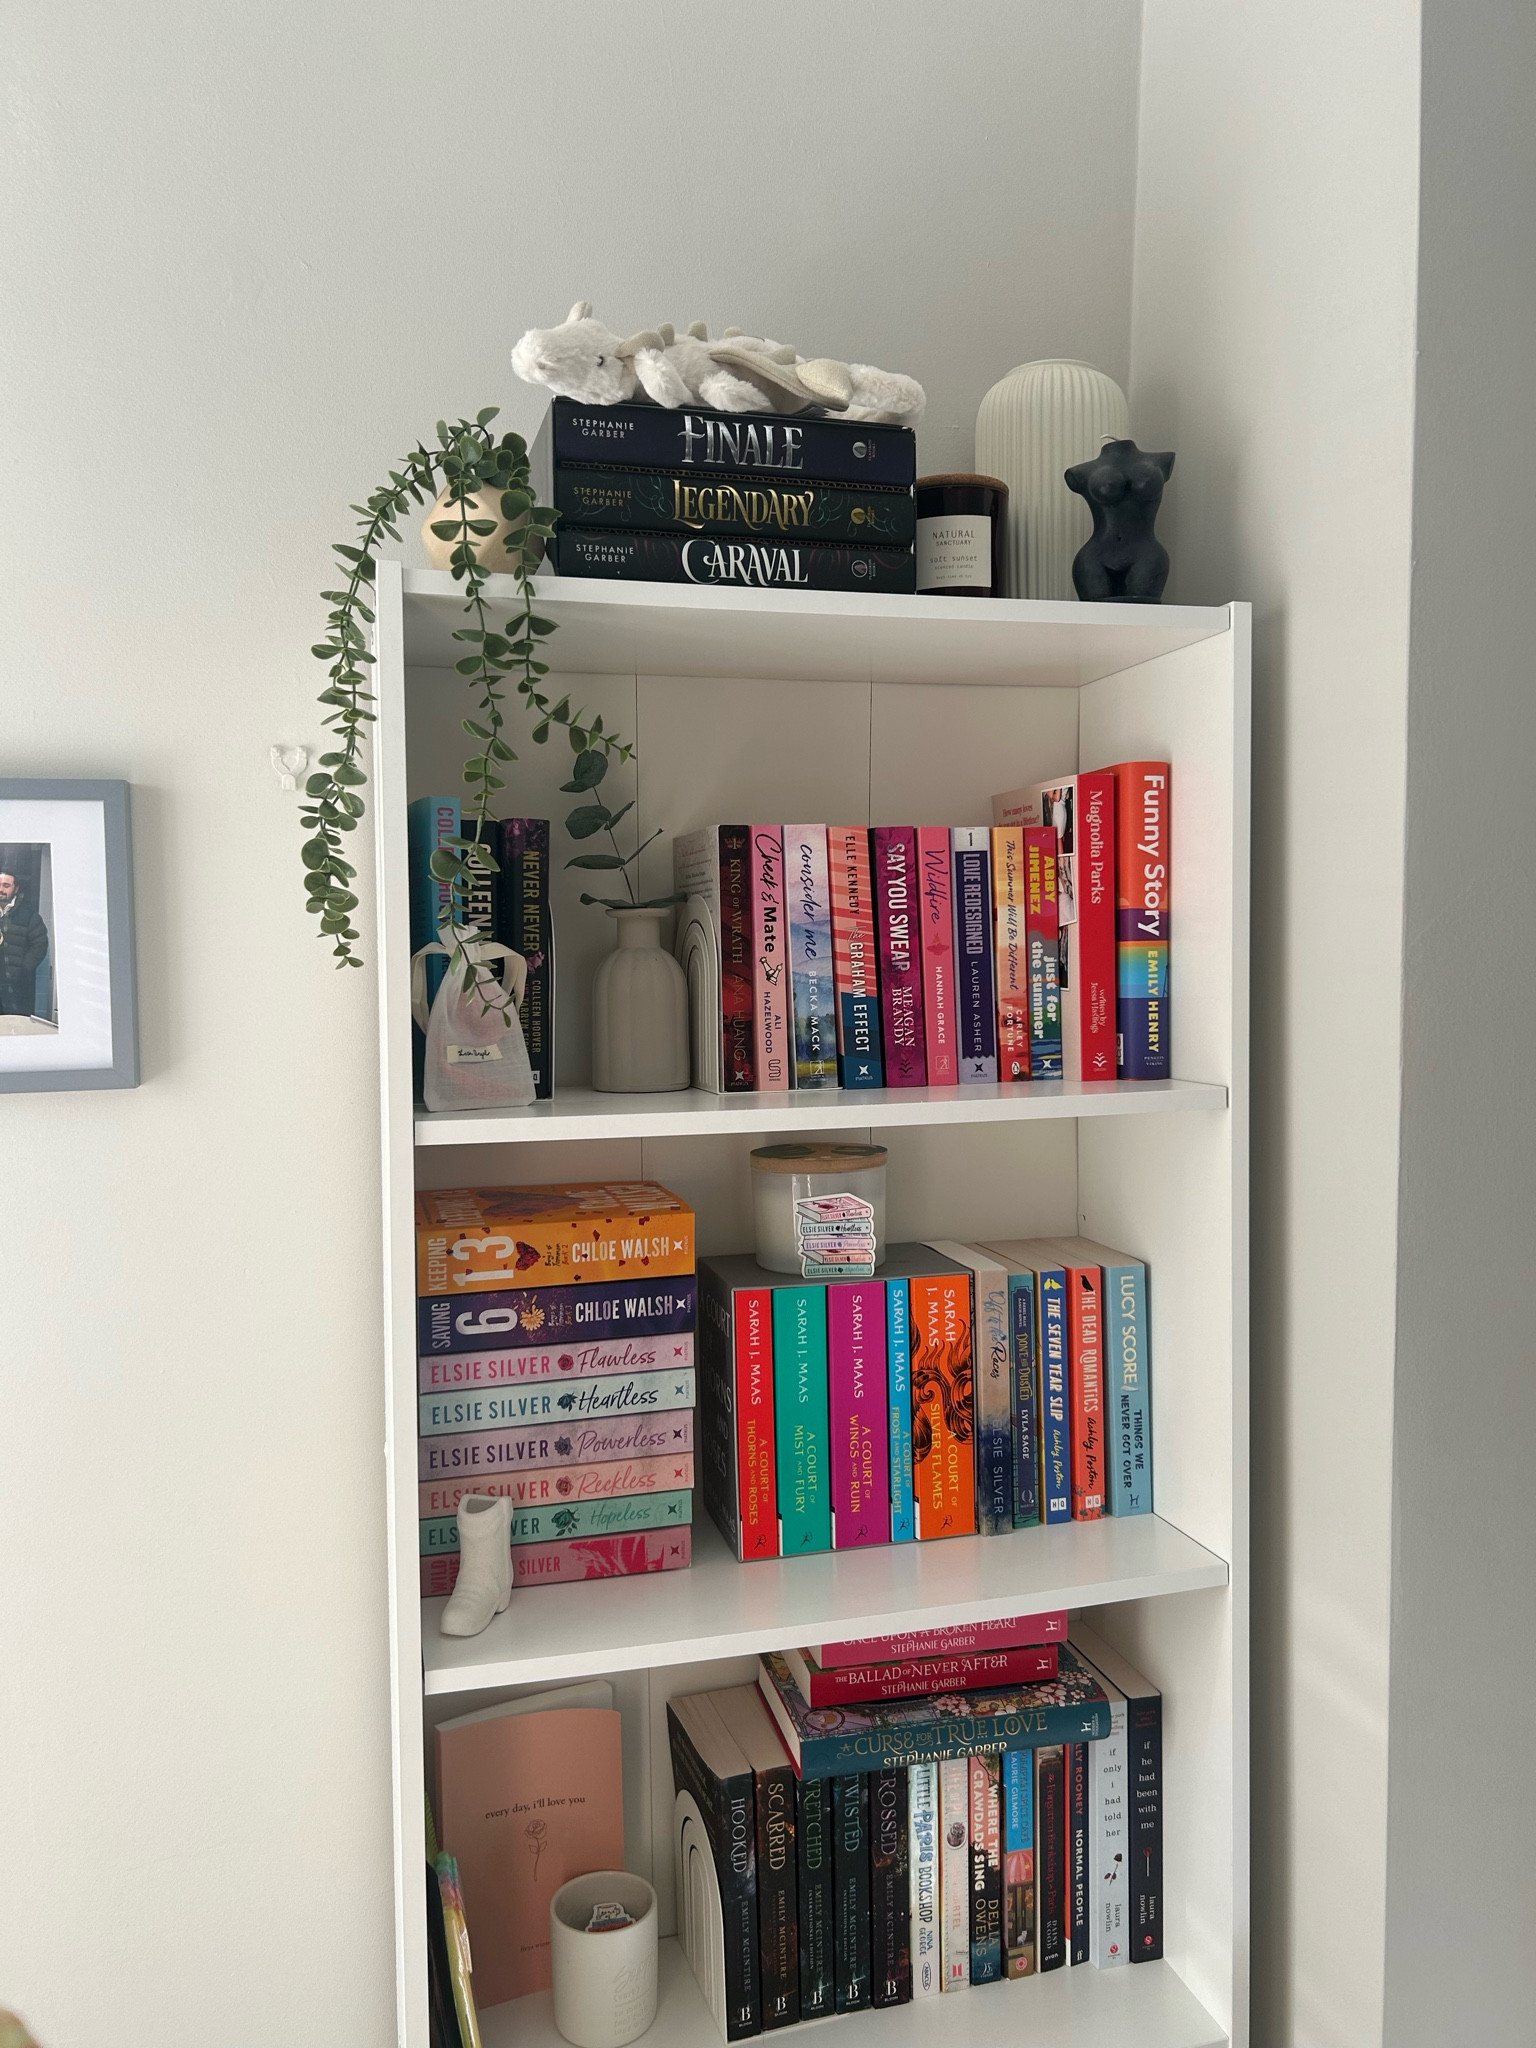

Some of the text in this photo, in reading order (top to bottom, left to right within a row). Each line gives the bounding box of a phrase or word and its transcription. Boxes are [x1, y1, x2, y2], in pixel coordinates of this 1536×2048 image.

[572, 418, 634, 430] STEPHANIE
[582, 428, 625, 438] GARBER
[677, 415, 804, 469] FINALE
[573, 486, 632, 498] STEPHANIE
[582, 497, 624, 506] GARBER
[672, 479, 815, 530] LEGENDARY
[576, 544, 634, 555] STEPHANIE
[585, 553, 626, 563] GARBER
[932, 530, 974, 539] NATURAL
[681, 538, 808, 586] CARAVAL
[755, 834, 782, 890] Check
[1086, 790, 1104, 904] Magnolia Parks
[1137, 775, 1164, 937] Funny Story
[523, 850, 540, 950] NEVER NEVER
[730, 859, 741, 893] KING
[800, 844, 822, 960] consider me
[846, 836, 859, 915] ELLE KENNEDY
[924, 849, 948, 924] Wildfire
[1029, 845, 1040, 914] JIMENEZ
[1044, 855, 1055, 903] ABBY
[764, 907, 777, 952] Mate
[886, 843, 910, 971] SAY YOU SWEAR
[963, 854, 983, 954] LOVE REDESIGNED
[1006, 840, 1018, 990] This Summer Will Be Different
[732, 911, 743, 963] WRATH
[850, 942, 866, 998] GRAHAM
[1032, 941, 1045, 1039] the summer
[1044, 955, 1058, 1022] just for
[532, 980, 541, 1053] COLLEEN HOOVER
[732, 974, 745, 1060] ANA HUANG
[764, 991, 773, 1053] HAZELWOOD
[809, 971, 820, 1051] BECKA MACK
[854, 1004, 869, 1052] EFFECT
[892, 988, 903, 1046] BRANDY
[901, 986, 915, 1047] MEAGAN
[935, 966, 945, 1044] HANNAH GRACE
[971, 961, 982, 1051] LAUREN ASHER
[1147, 951, 1159, 1053] EMILY HENRY
[1006, 1006, 1014, 1052] FORTUNE
[428, 1237, 447, 1291] KEEPING
[451, 1235, 515, 1286] 13
[572, 1236, 670, 1263] CHLOE WALSH
[432, 1302, 451, 1349] SAVING
[455, 1307, 518, 1335] 6
[575, 1295, 673, 1322] CHLOE WALSH
[926, 1287, 939, 1347] J. MAAS
[944, 1289, 956, 1342] SARAH
[1082, 1290, 1095, 1310] THE
[749, 1300, 761, 1405] SARAH J. MAAS
[797, 1299, 808, 1403] SARAH J. MAAS
[1083, 1315, 1096, 1344] DEAD
[1120, 1276, 1138, 1383] LUCY SCORE
[431, 1355, 550, 1384] ELSIE SILVER
[577, 1343, 656, 1375] Flawless
[1048, 1297, 1063, 1421] THE SEVEN YEAR SLIP
[578, 1382, 658, 1413] Heartless
[577, 1424, 666, 1457] Powerless
[747, 1419, 756, 1467] THORNS
[794, 1425, 804, 1456] MIST
[849, 1415, 860, 1458] WINGS
[930, 1403, 942, 1509] SILVER FLAMES
[1022, 1435, 1030, 1459] SAGE
[1051, 1429, 1063, 1489] Ashley Poston
[1083, 1418, 1098, 1489] Ashley Poston
[1121, 1395, 1132, 1488] NEVER GOT OVER
[1133, 1409, 1144, 1470] THINGS WE
[577, 1465, 656, 1497] Reckless
[748, 1487, 758, 1525] ROSES
[795, 1479, 805, 1513] FURY
[850, 1481, 860, 1513] RUIN
[590, 1503, 650, 1530] Hopeless
[848, 1668, 902, 1685] BALLAD
[911, 1661, 957, 1678] NEVER
[961, 1655, 1008, 1671] AFTER
[882, 1677, 967, 1696] STEPHANIE GARBER
[485, 1796, 586, 1820] every day, i'll love you
[1010, 1751, 1019, 1830] LAURIE GILMORE
[730, 1798, 746, 1872] HOOKED
[766, 1784, 786, 1870] SCARRED
[914, 1769, 935, 1923] LITTLE PARIS BOOKSHOP
[973, 1770, 985, 1891] CRAWDADS SING
[988, 1785, 998, 1867] WHERE THE
[1075, 1829, 1084, 1926] NORMAL PEOPLE
[975, 1899, 986, 1957] OWENS
[987, 1899, 998, 1946] DELIA
[1105, 1903, 1113, 1932] nowlin
[1139, 1895, 1147, 1924] nowlin
[1148, 1896, 1156, 1919] laura
